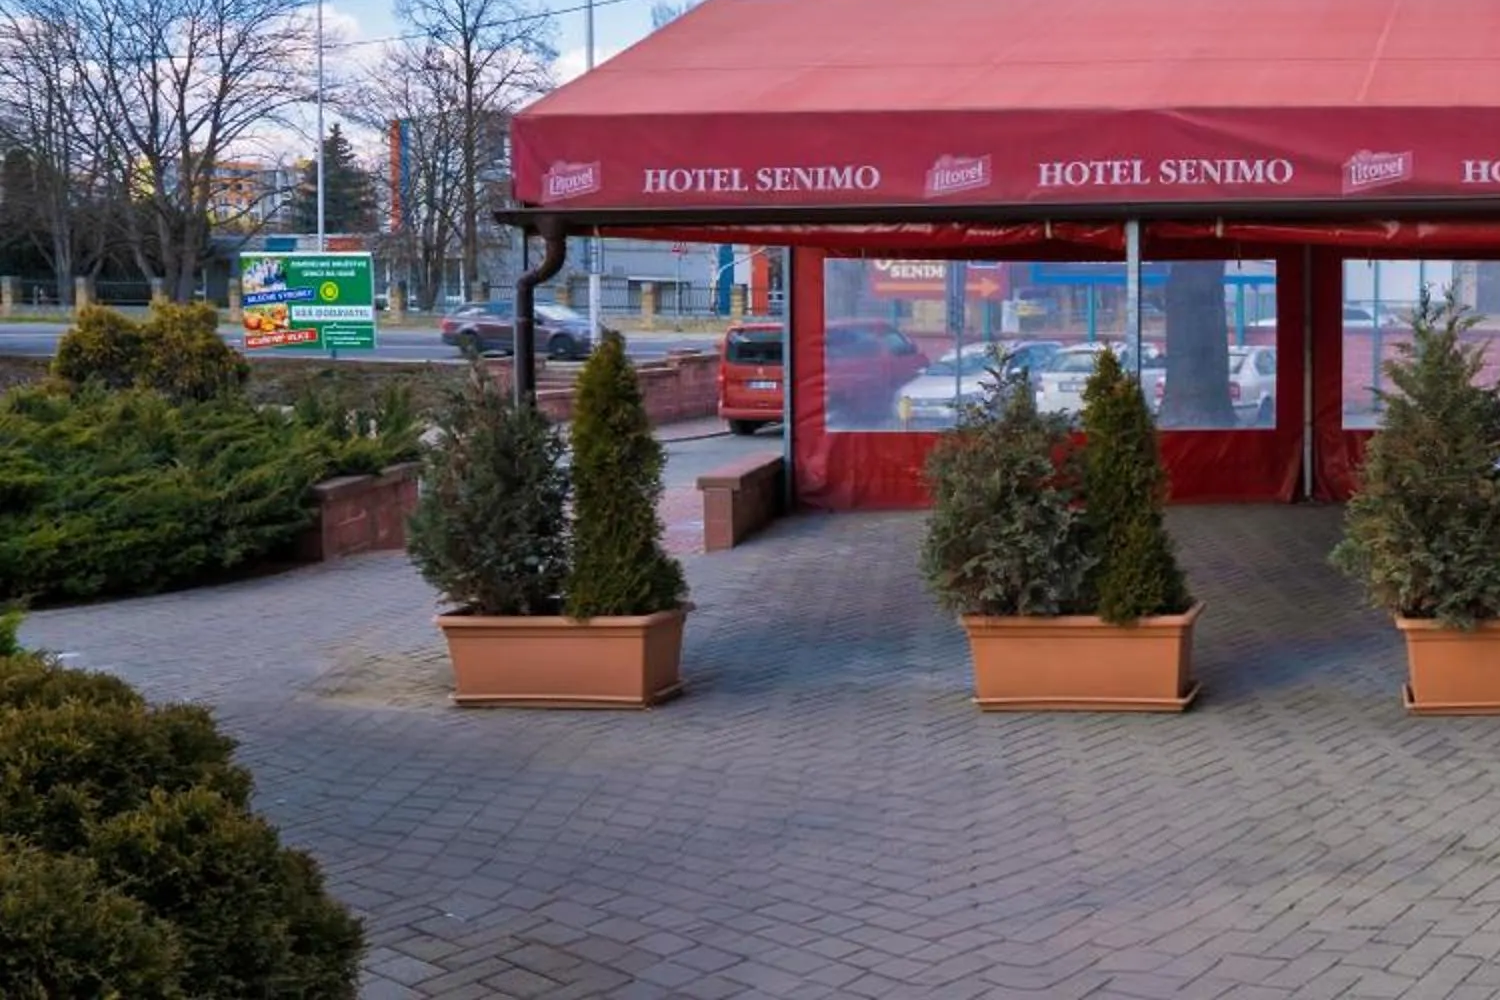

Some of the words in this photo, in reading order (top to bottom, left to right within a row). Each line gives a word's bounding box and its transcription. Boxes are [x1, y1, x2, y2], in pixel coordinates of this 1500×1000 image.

[643, 168, 749, 193] HOTEL
[756, 165, 881, 191] SENIMO
[1038, 160, 1150, 187] HOTEL
[1159, 158, 1294, 185] SENIMO
[890, 264, 946, 279] SENIM
